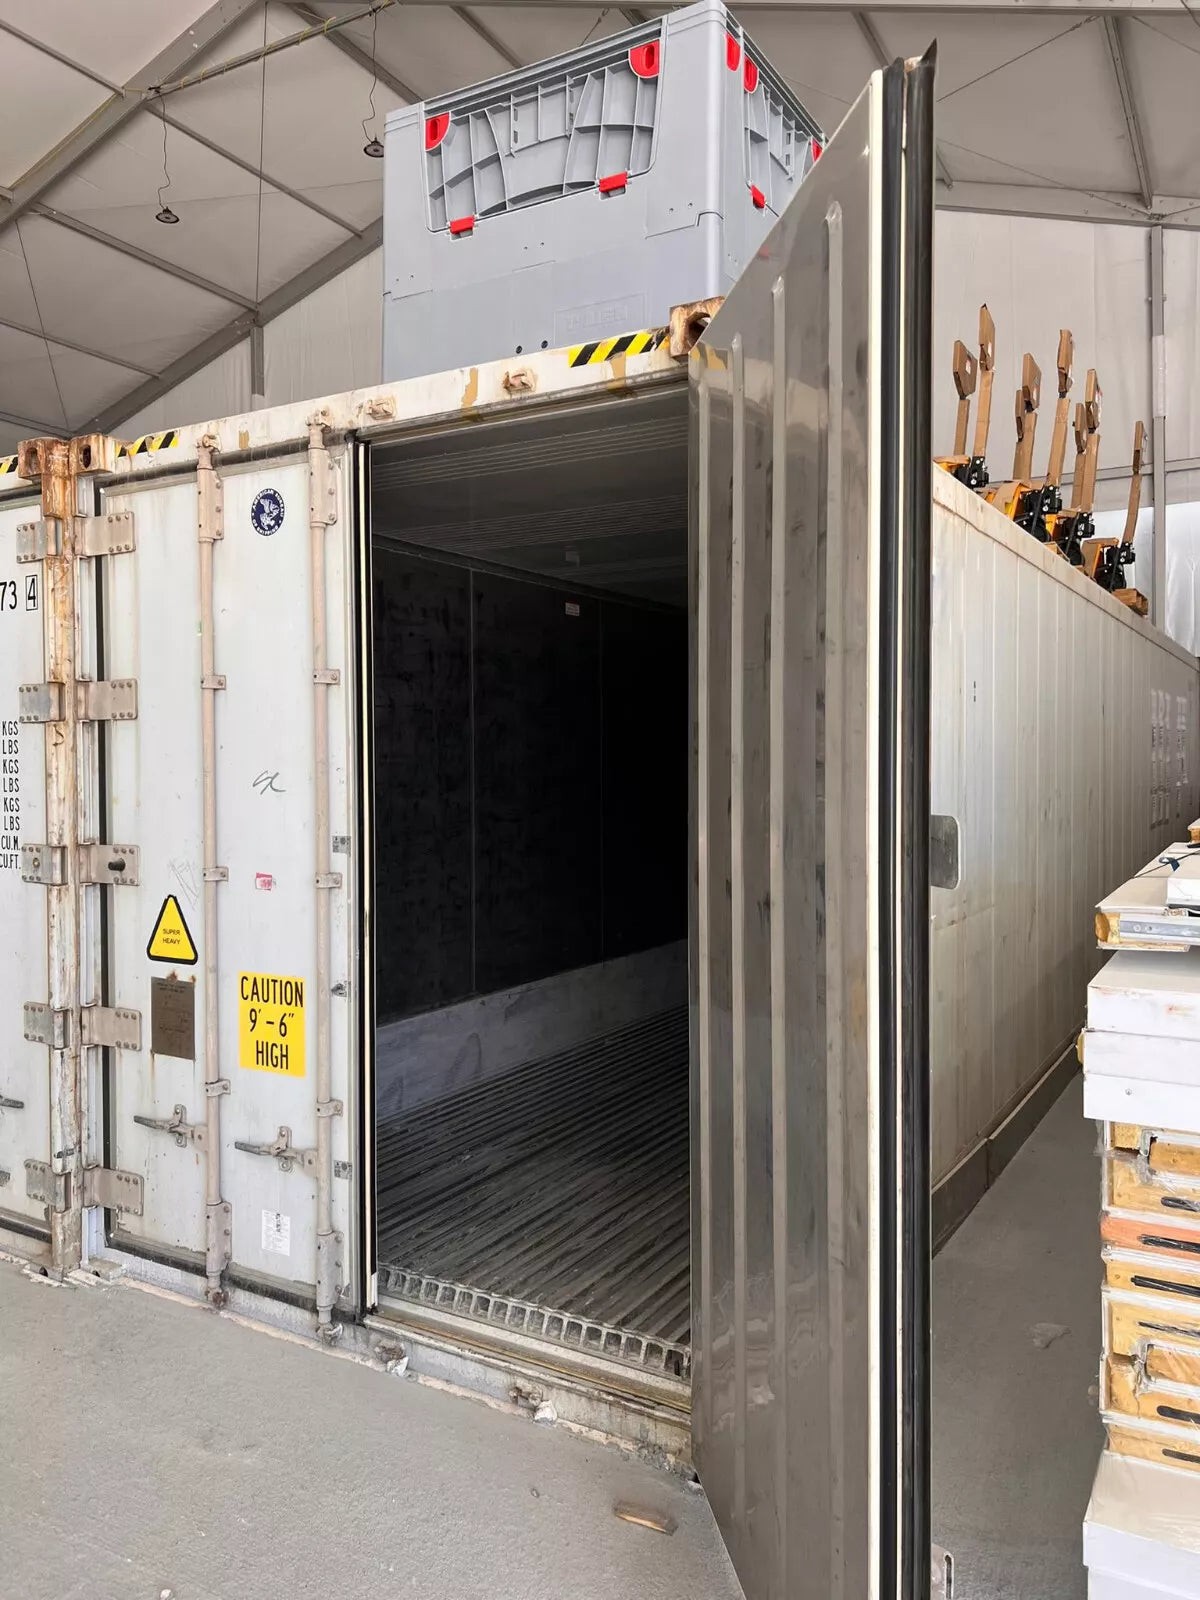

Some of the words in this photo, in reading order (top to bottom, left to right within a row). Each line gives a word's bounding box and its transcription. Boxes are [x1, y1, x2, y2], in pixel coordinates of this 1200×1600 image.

[27, 577, 37, 608] 4
[2, 720, 19, 736] KGS
[2, 739, 19, 755] LBS
[2, 759, 19, 774] KGS
[3, 777, 20, 793] LBS
[3, 797, 20, 812] KGS
[3, 816, 20, 831] LBS
[162, 928, 180, 936] SUPER
[162, 937, 180, 945] HEAVY
[240, 975, 304, 1008] CAUTION
[255, 1039, 289, 1070] HIGH
